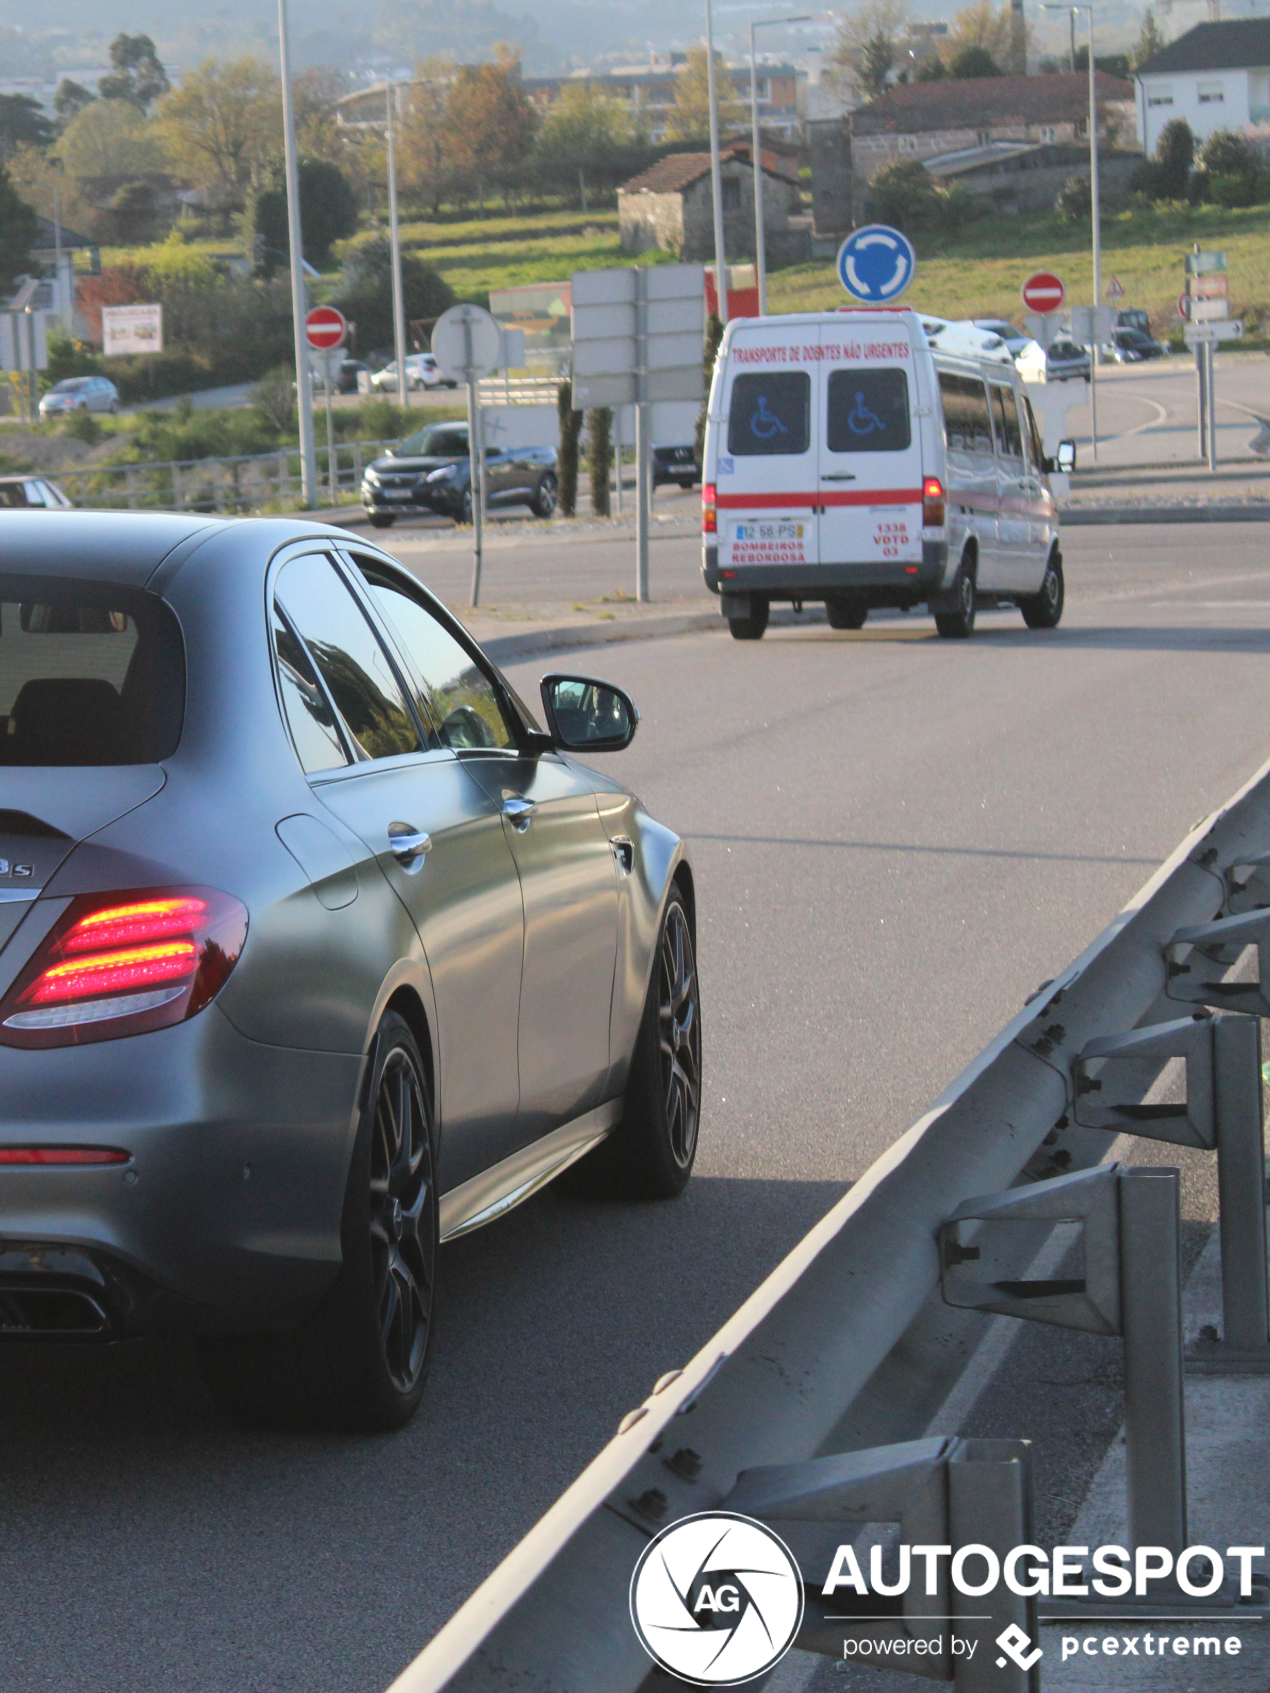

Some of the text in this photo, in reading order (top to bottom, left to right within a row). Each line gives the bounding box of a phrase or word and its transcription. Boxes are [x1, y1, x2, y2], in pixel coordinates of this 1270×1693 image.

[732, 340, 909, 363] TRANSPORTE DE DOENTES NÃO URGENTES
[877, 523, 906, 533] 1338
[733, 541, 804, 551] BOMBEIROS
[732, 552, 805, 562] REBORDOSA
[883, 547, 898, 557] 03
